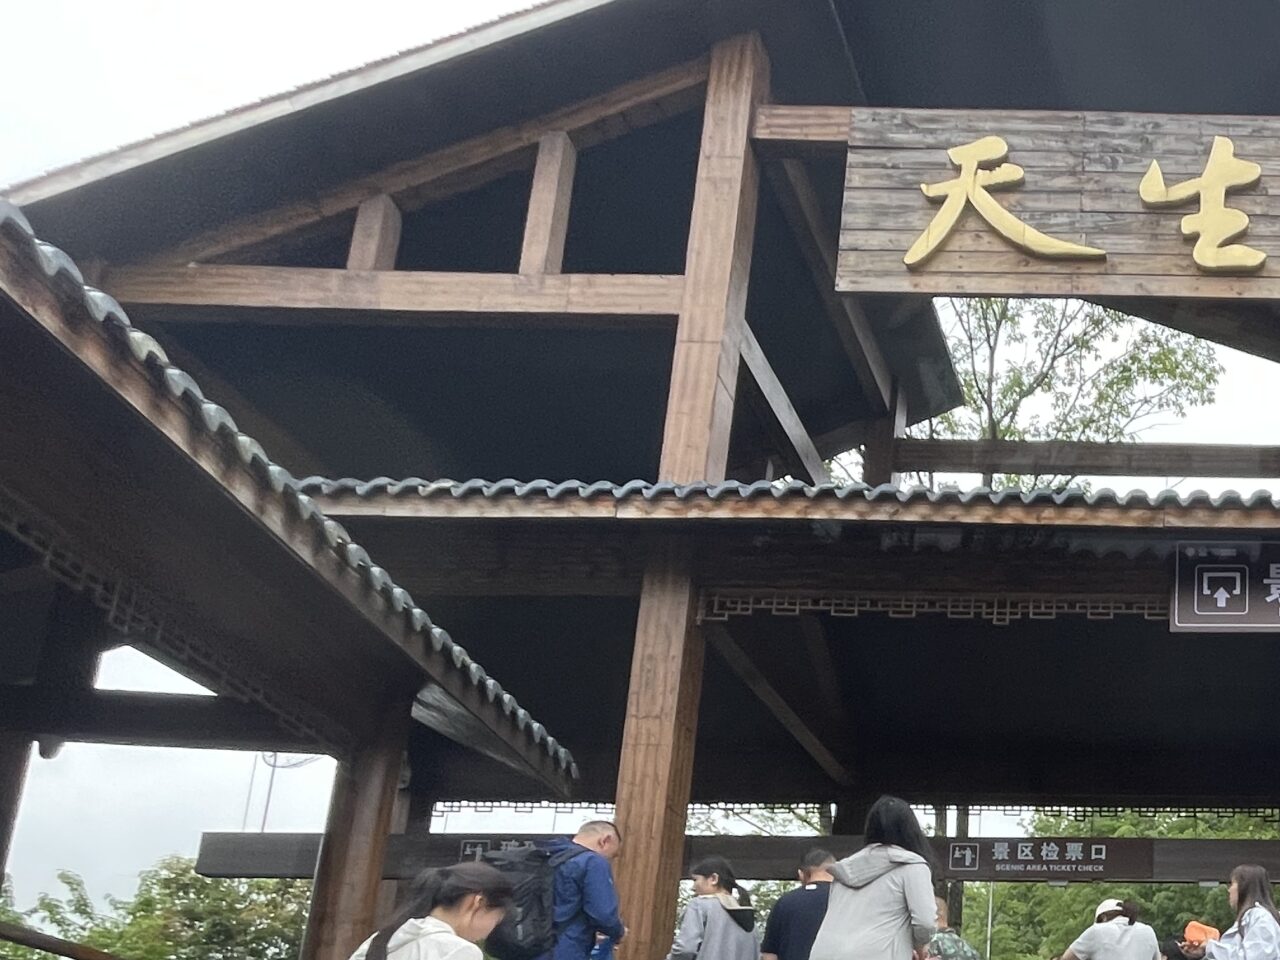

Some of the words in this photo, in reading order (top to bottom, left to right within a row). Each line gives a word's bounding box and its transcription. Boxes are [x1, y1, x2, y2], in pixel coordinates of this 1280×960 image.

[992, 842, 1107, 861] 景区检票口
[995, 864, 1025, 872] SCENIC
[1026, 864, 1048, 872] AREA
[1049, 864, 1077, 872] TICKET
[1077, 864, 1104, 872] CHECK
